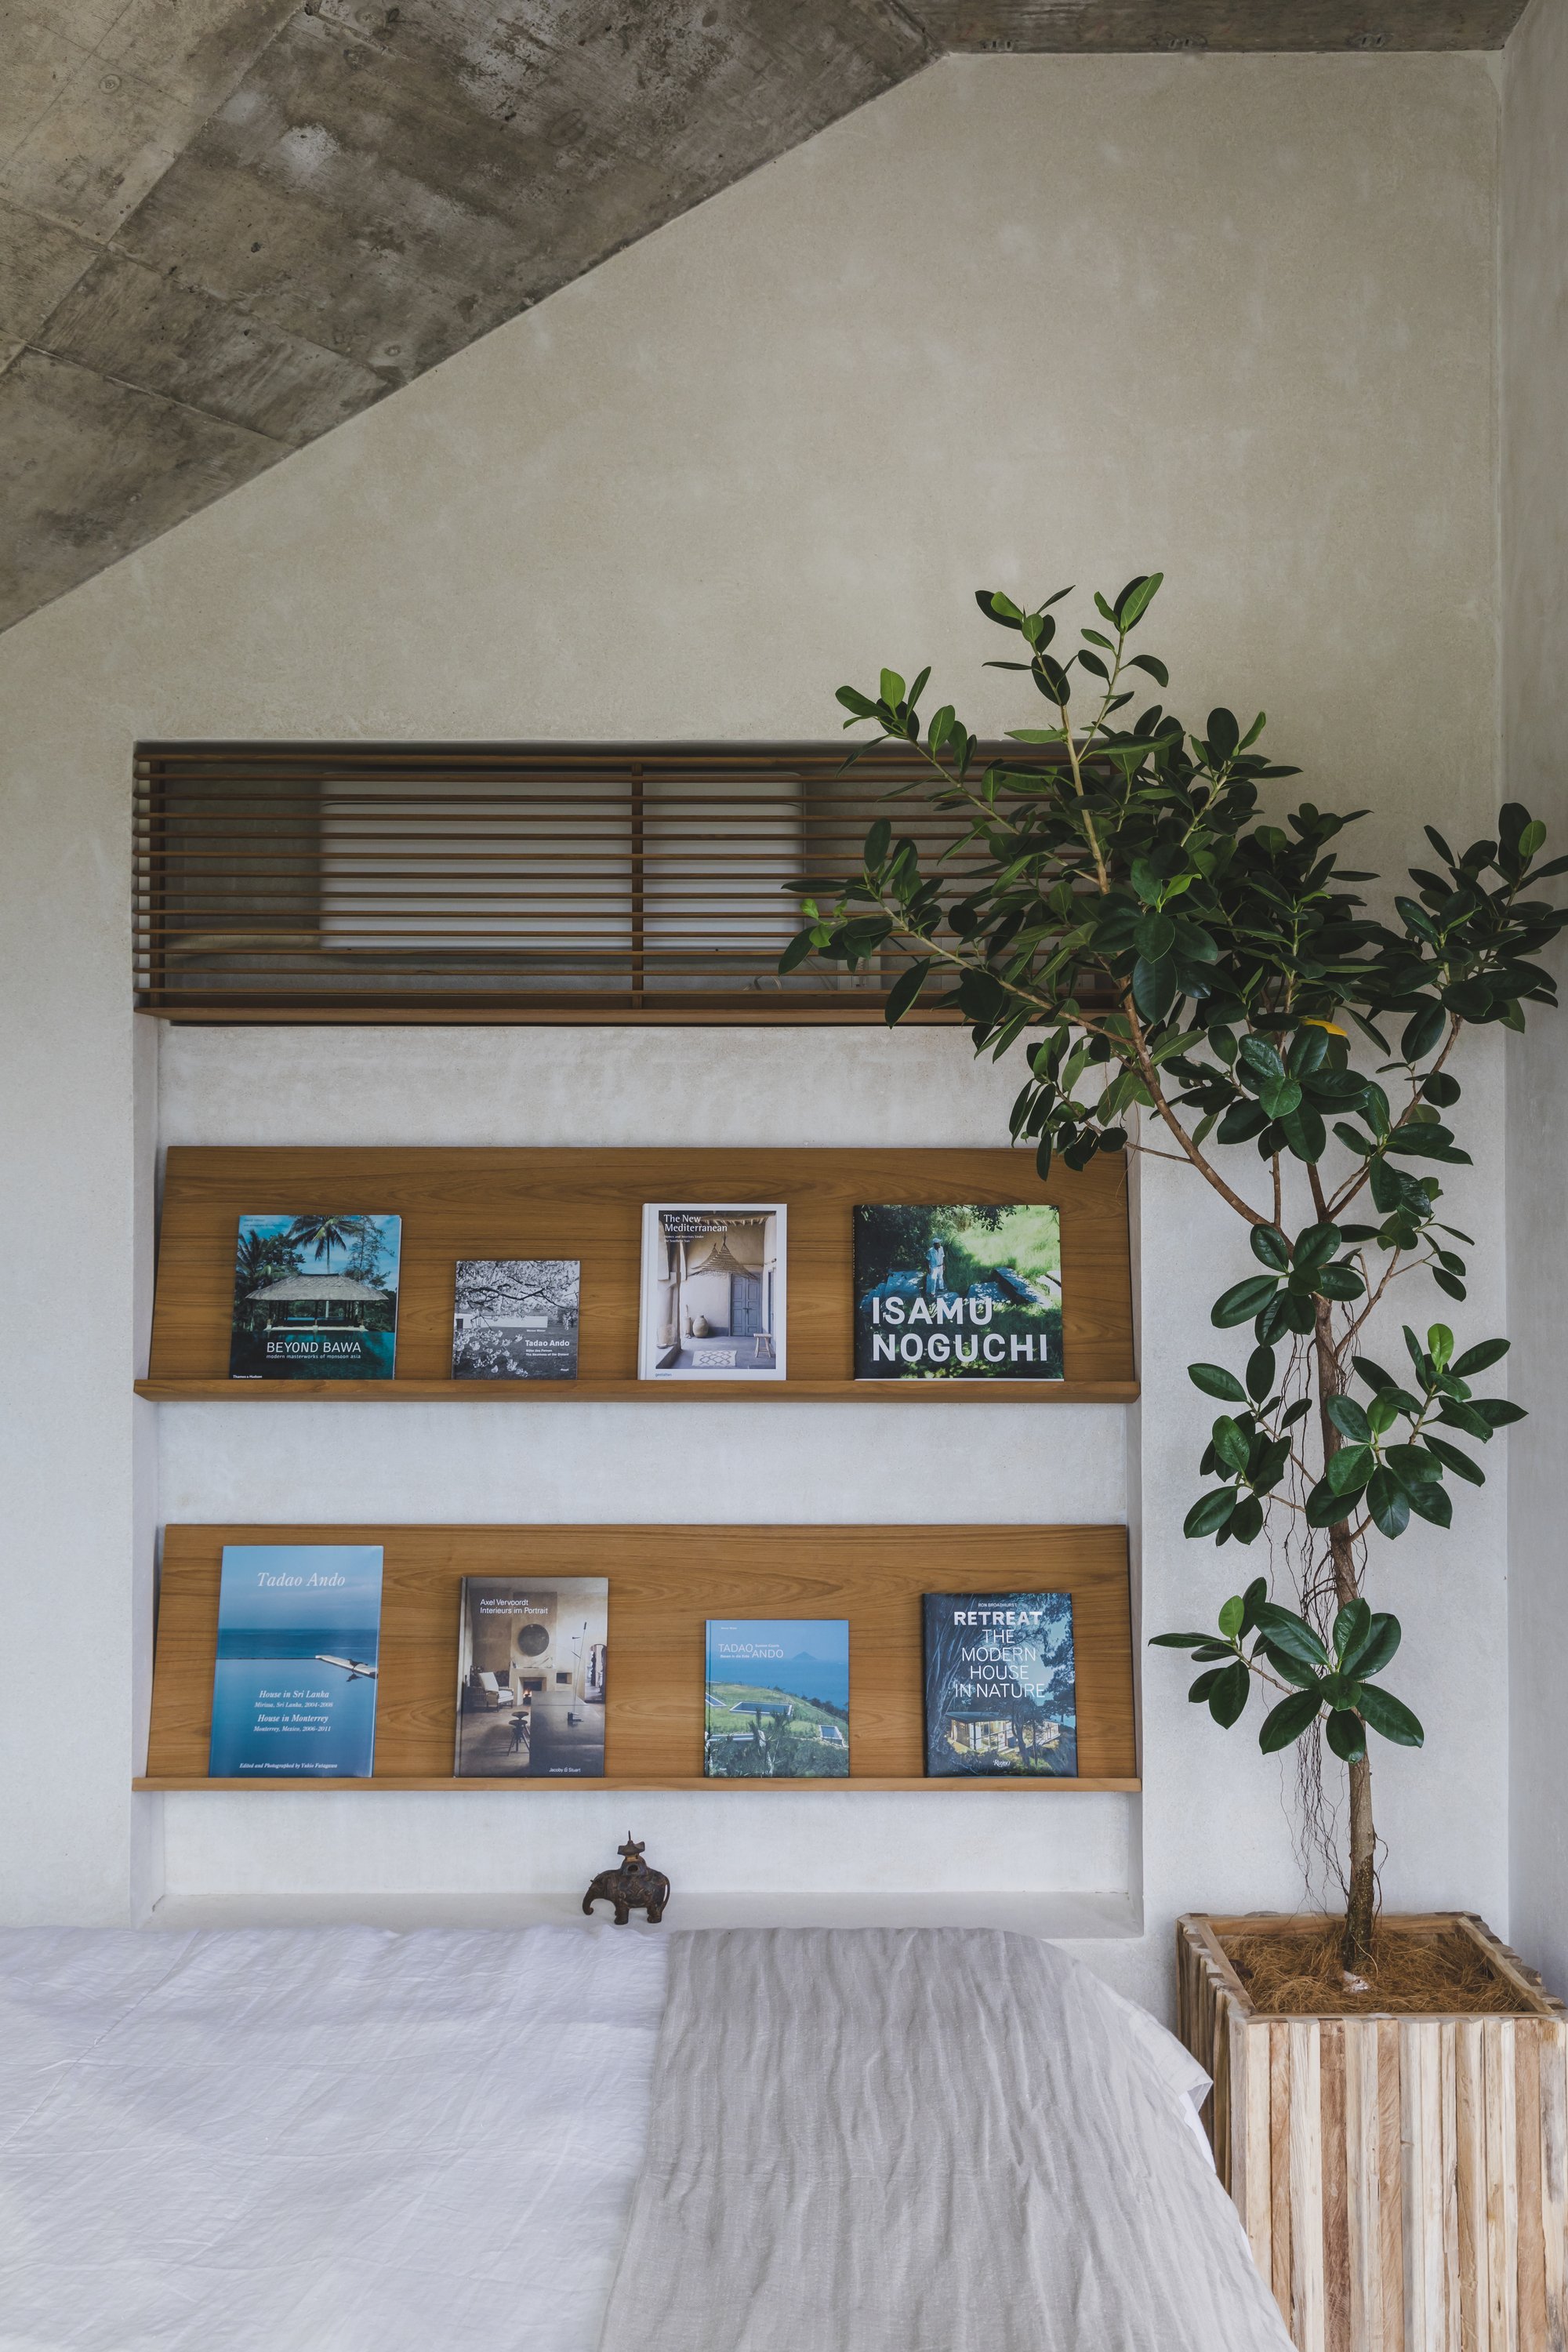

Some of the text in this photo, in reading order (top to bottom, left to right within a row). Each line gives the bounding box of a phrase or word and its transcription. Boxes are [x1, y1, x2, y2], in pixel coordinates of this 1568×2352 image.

[664, 1214, 702, 1223] The New
[665, 1224, 728, 1232] Mediterranean
[873, 1297, 993, 1325] ISAMU
[267, 1342, 361, 1353] BEYOND BAWA
[873, 1334, 1047, 1362] NOGUCHI
[257, 1572, 346, 1587] Tadao Ando
[953, 1611, 1043, 1625] RETREAT
[982, 1629, 1016, 1644] THE
[718, 1643, 753, 1653] TADAO
[753, 1650, 784, 1658] ANDO
[962, 1647, 1036, 1662] MODERN
[970, 1665, 1030, 1680] HOUSE
[955, 1683, 1046, 1698] IN NATURE
[257, 1714, 329, 1723] House in Monterrey
